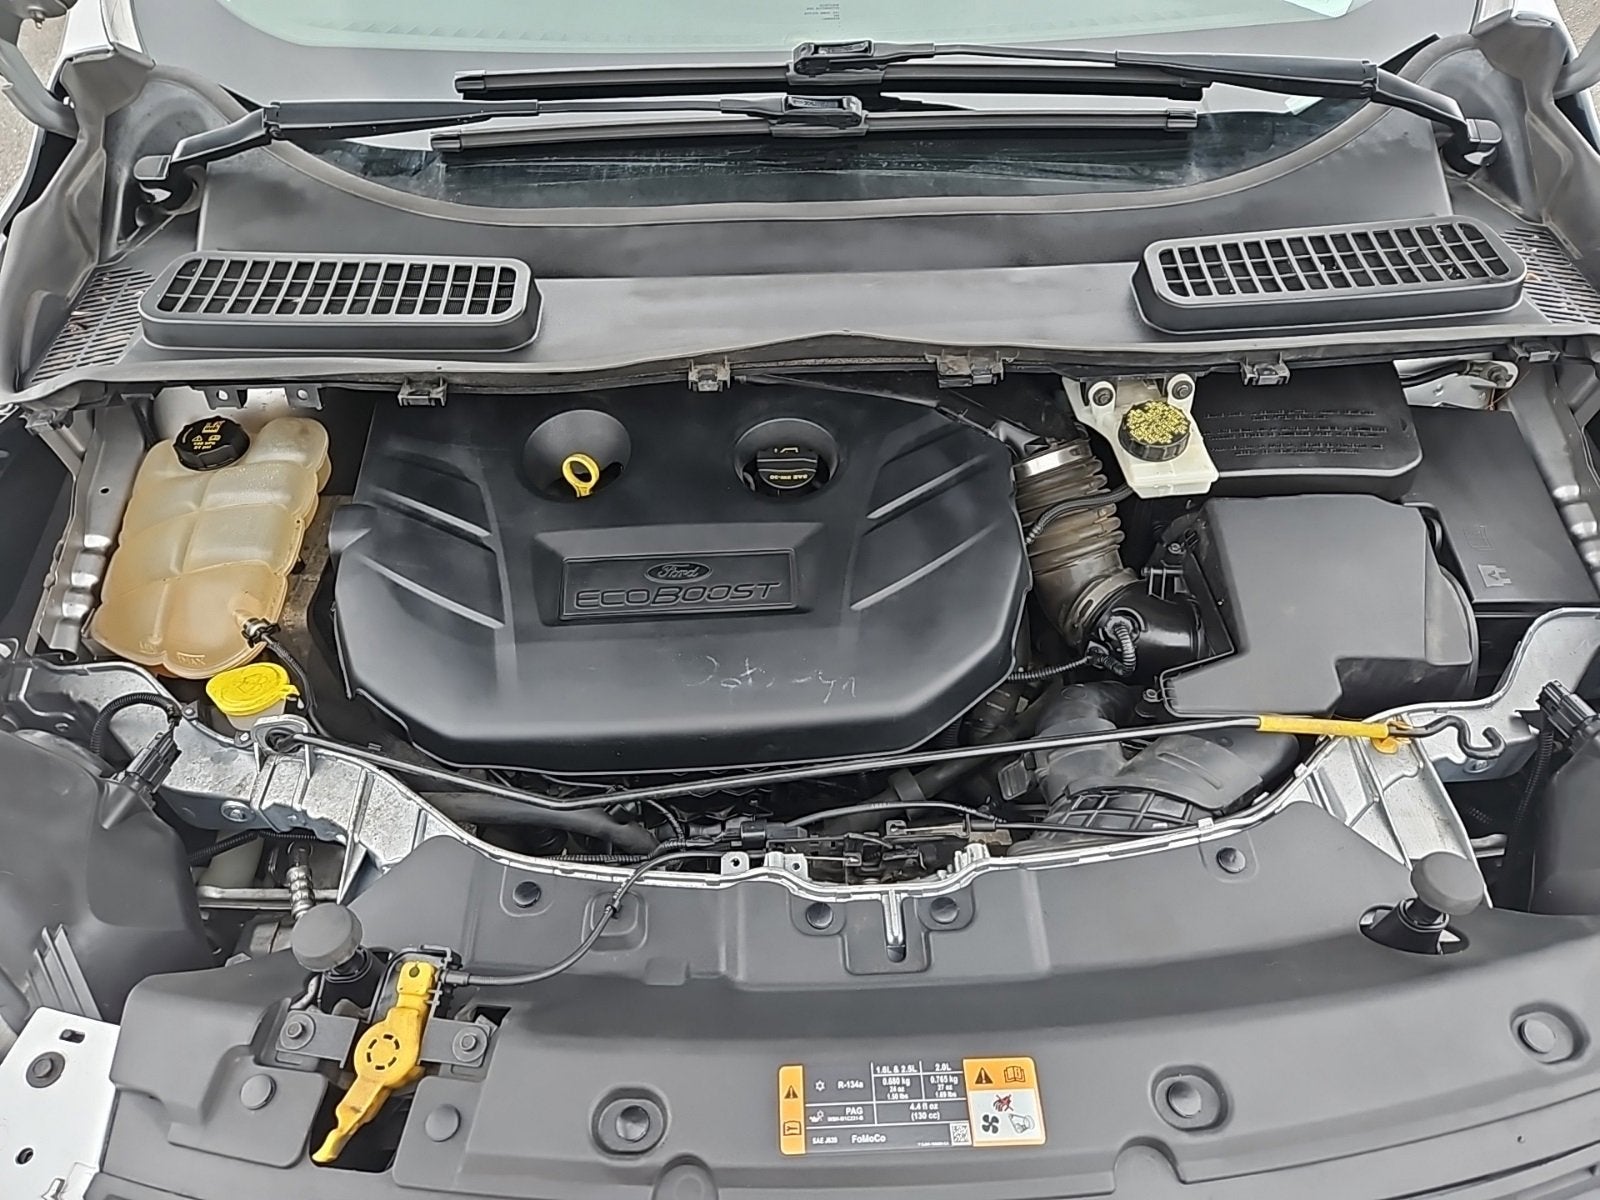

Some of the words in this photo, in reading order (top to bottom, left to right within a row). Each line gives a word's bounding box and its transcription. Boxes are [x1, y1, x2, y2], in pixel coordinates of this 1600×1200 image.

[657, 563, 700, 578] Ford
[893, 1064, 900, 1073] &
[935, 1062, 952, 1072] 2.0L
[837, 1080, 864, 1089] R-134a
[901, 1077, 911, 1087] kg
[949, 1075, 959, 1085] kg
[845, 1106, 863, 1115] PAG
[910, 1102, 921, 1110] 4.4
[911, 1111, 927, 1121] (130
[928, 1111, 940, 1121] cc)
[851, 1133, 886, 1144] FoMoCo
